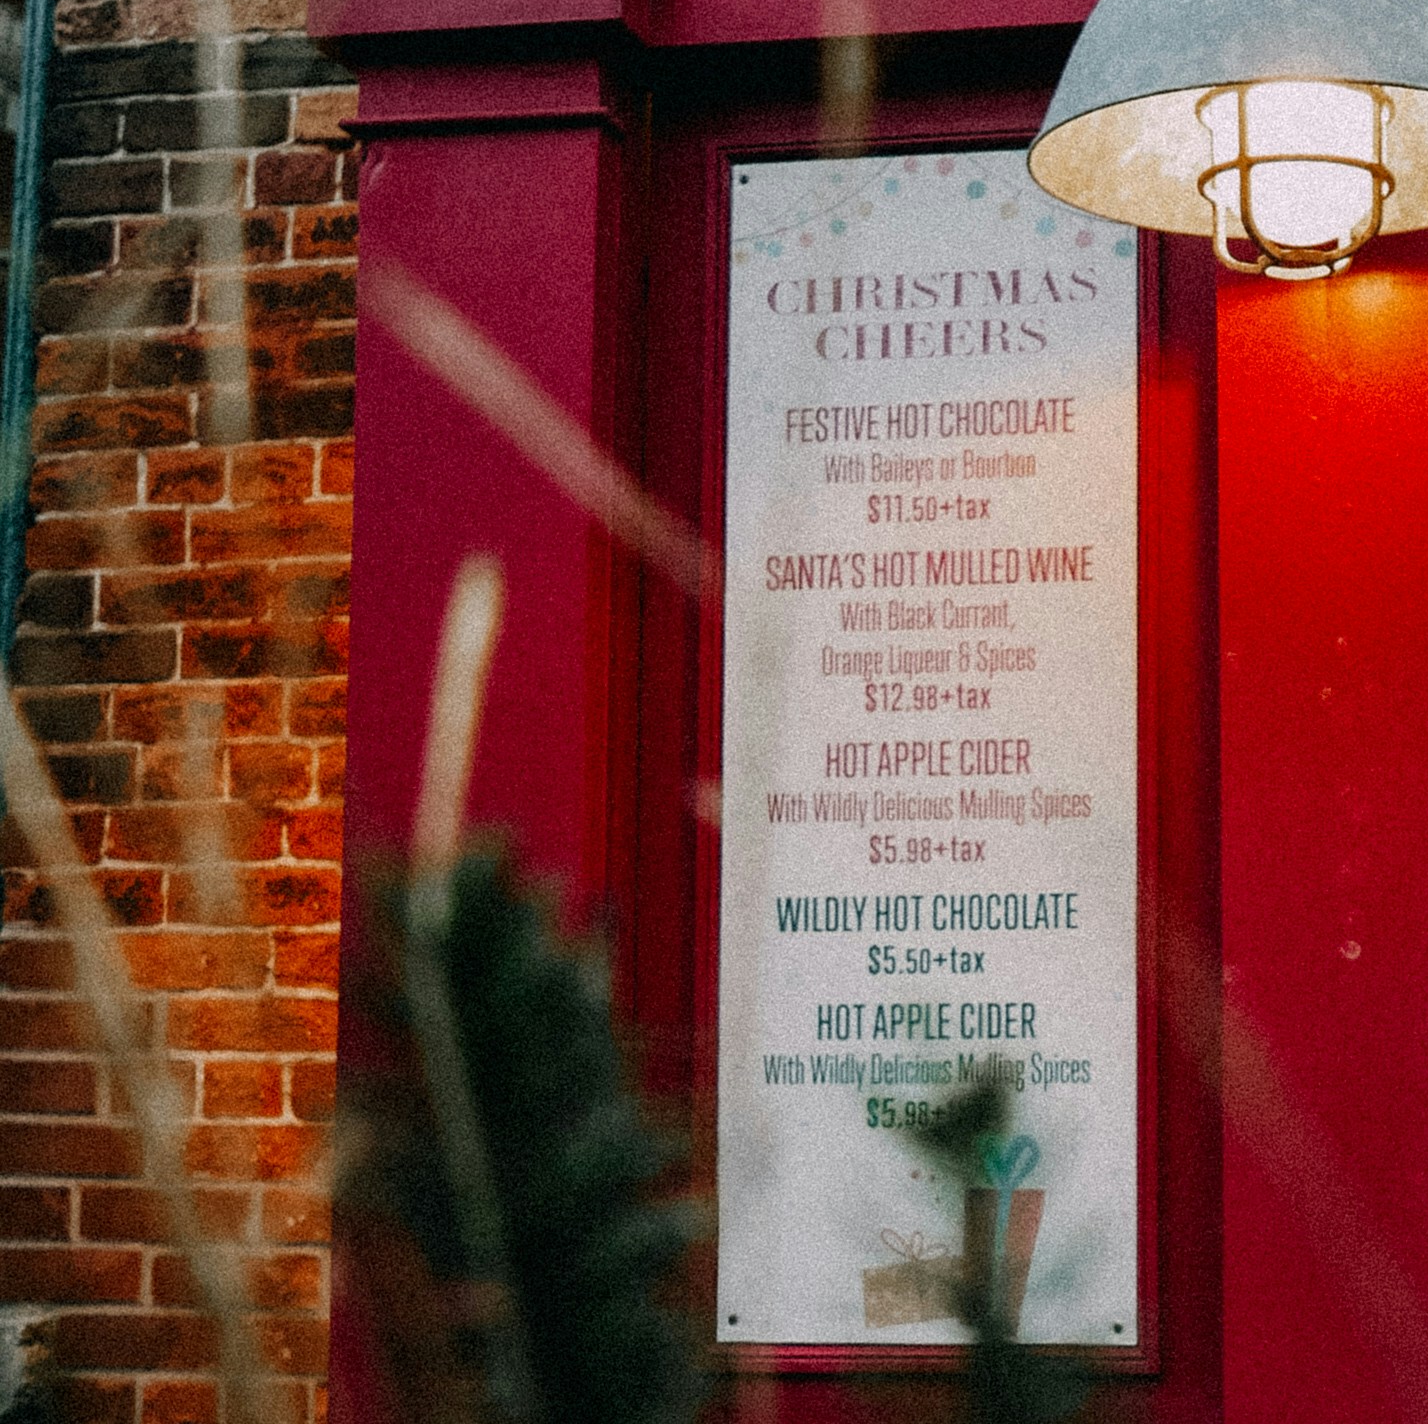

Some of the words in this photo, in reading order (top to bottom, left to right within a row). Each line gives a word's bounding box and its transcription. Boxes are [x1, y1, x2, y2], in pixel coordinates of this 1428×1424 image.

[766, 266, 1099, 315] CHRISTMAS
[815, 318, 1048, 360] CHEERS
[786, 404, 879, 444] FESTIVE
[887, 401, 933, 441] HOT
[939, 396, 1076, 439] CHOCOLATE
[824, 453, 865, 484] With
[871, 451, 933, 489] Baileys
[939, 456, 957, 479] or
[962, 448, 1036, 480] Bourbon
[867, 493, 991, 525] $11.50+tax
[766, 551, 866, 592] SANTA'S
[873, 549, 920, 588] HOT
[925, 547, 1020, 586] MULLED
[1026, 545, 1094, 584] WINE
[840, 601, 881, 632] With
[888, 599, 935, 632] Black
[942, 597, 1015, 633] Currant,
[821, 644, 883, 682] Orange
[889, 643, 952, 680] Liqueur
[958, 642, 970, 673] &
[976, 640, 1037, 679] Spices
[865, 683, 992, 713] $12.98+tax
[825, 742, 872, 778] HOT
[877, 740, 952, 777] APPLE
[959, 738, 1032, 776] CIDER
[766, 792, 806, 824] With
[813, 790, 867, 828] Wildly
[873, 789, 953, 823] Delicious
[959, 788, 1025, 826] Mulling
[1031, 786, 1093, 825] Spices
[869, 834, 986, 864] $5.98+tax
[776, 895, 868, 933] WILDLY
[875, 894, 925, 932] HOT
[932, 892, 1080, 931] CHOCOLATE
[867, 944, 986, 975] $5.50+tax
[816, 1003, 866, 1041] HOT
[872, 1002, 952, 1041] APPLE
[959, 1001, 1037, 1040] CIDER
[763, 1054, 804, 1086] With
[810, 1052, 865, 1091] Wildly
[871, 1052, 952, 1086] Delicious
[958, 1052, 1025, 1093] Mulling
[1031, 1051, 1092, 1092] Spices
[866, 1097, 948, 1128] $5.98+
